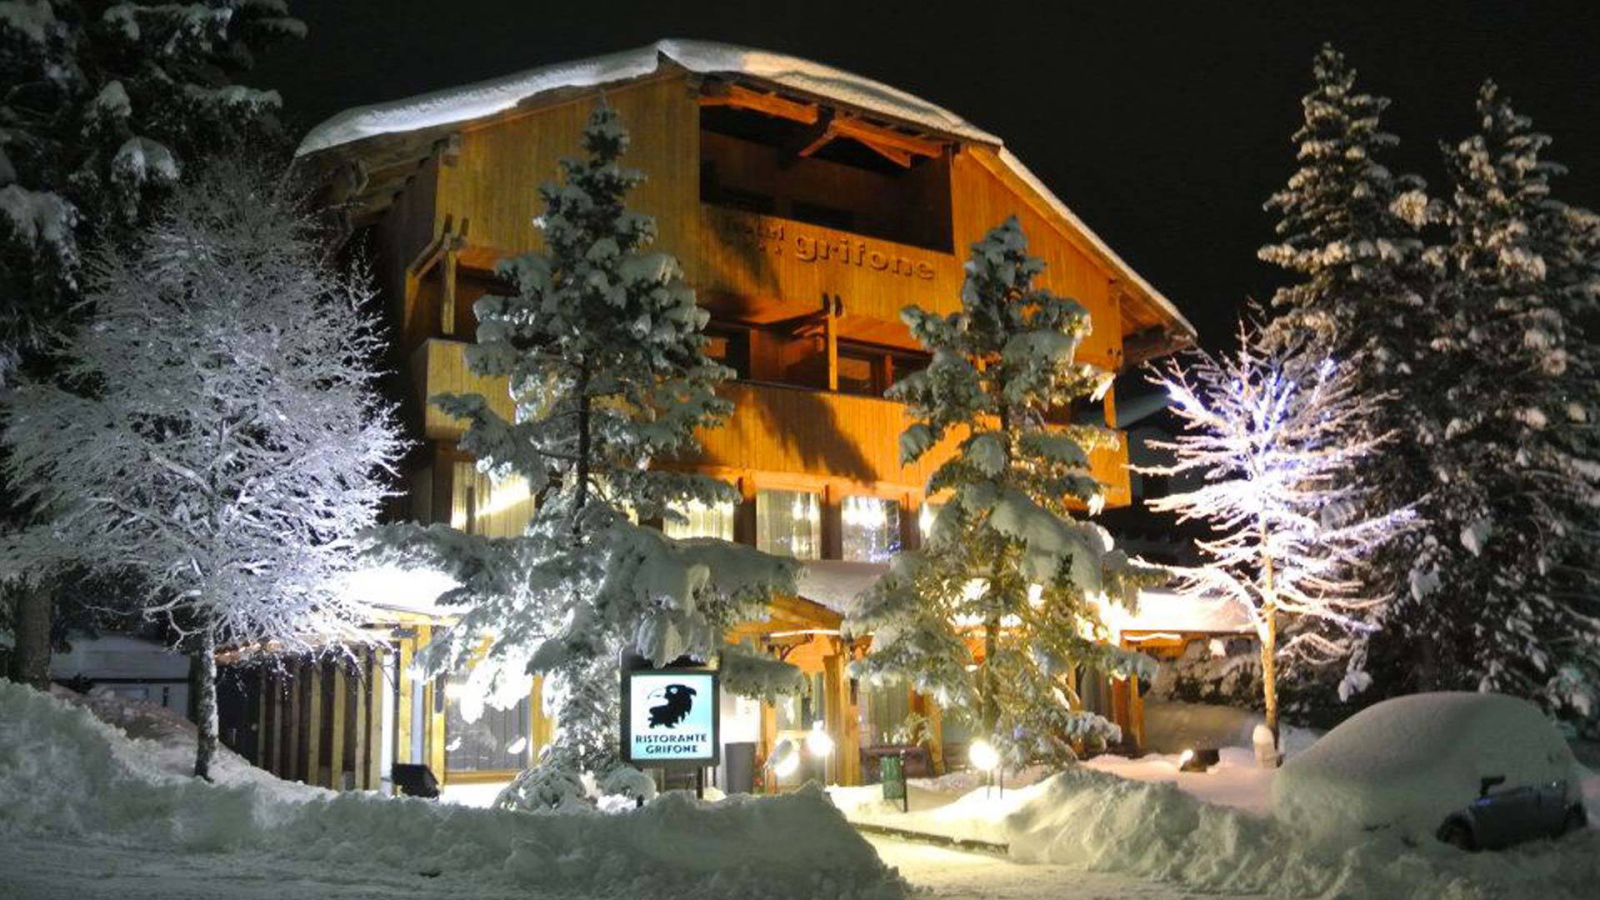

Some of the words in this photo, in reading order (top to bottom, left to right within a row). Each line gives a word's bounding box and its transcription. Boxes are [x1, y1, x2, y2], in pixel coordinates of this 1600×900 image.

[796, 235, 935, 280] grifone
[635, 733, 707, 744] RISTORANTE
[645, 744, 698, 755] GRIFONE
